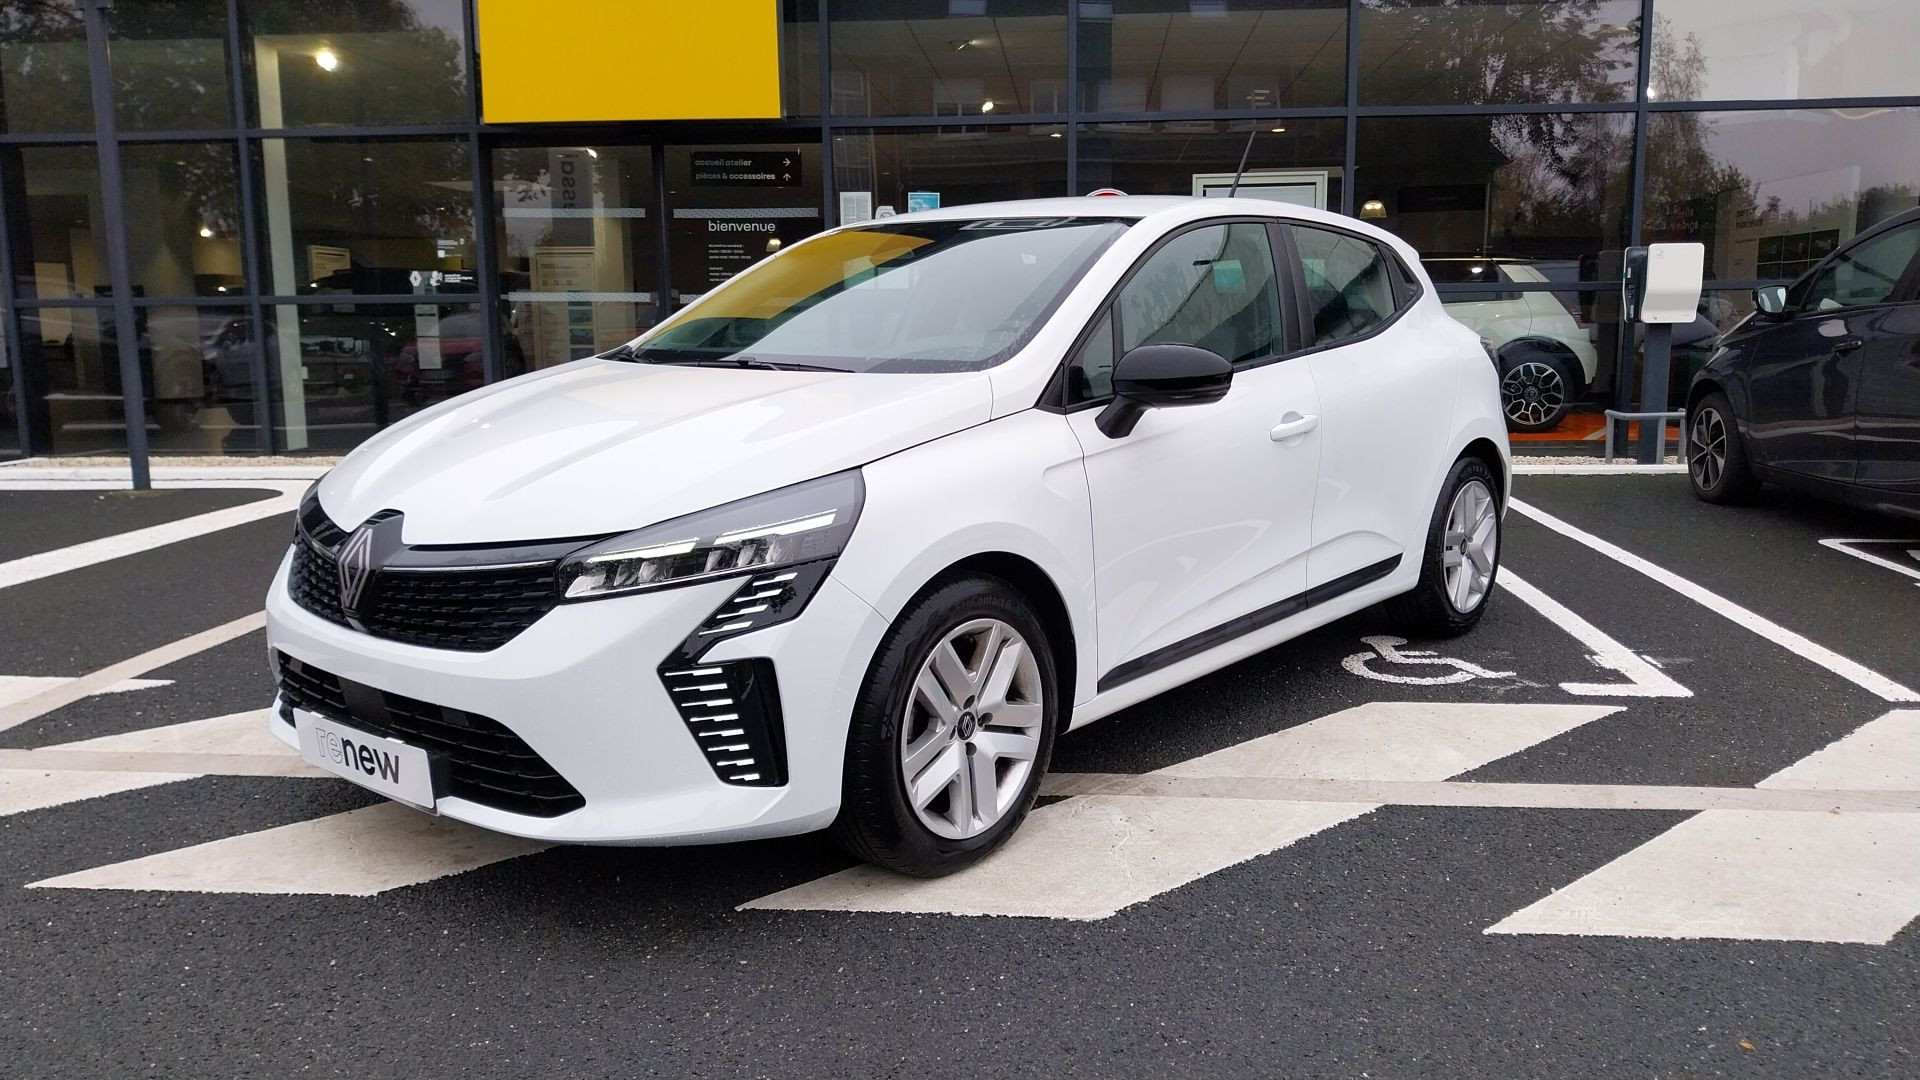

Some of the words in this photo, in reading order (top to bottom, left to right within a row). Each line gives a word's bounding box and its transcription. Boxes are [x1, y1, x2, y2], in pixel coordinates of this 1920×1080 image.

[694, 159, 724, 167] accueil
[725, 159, 752, 167] atelier
[695, 172, 721, 181] pièces
[721, 172, 728, 180] &
[729, 172, 776, 180] accessoires
[708, 220, 776, 232] bienvenue
[315, 727, 399, 784] renew
